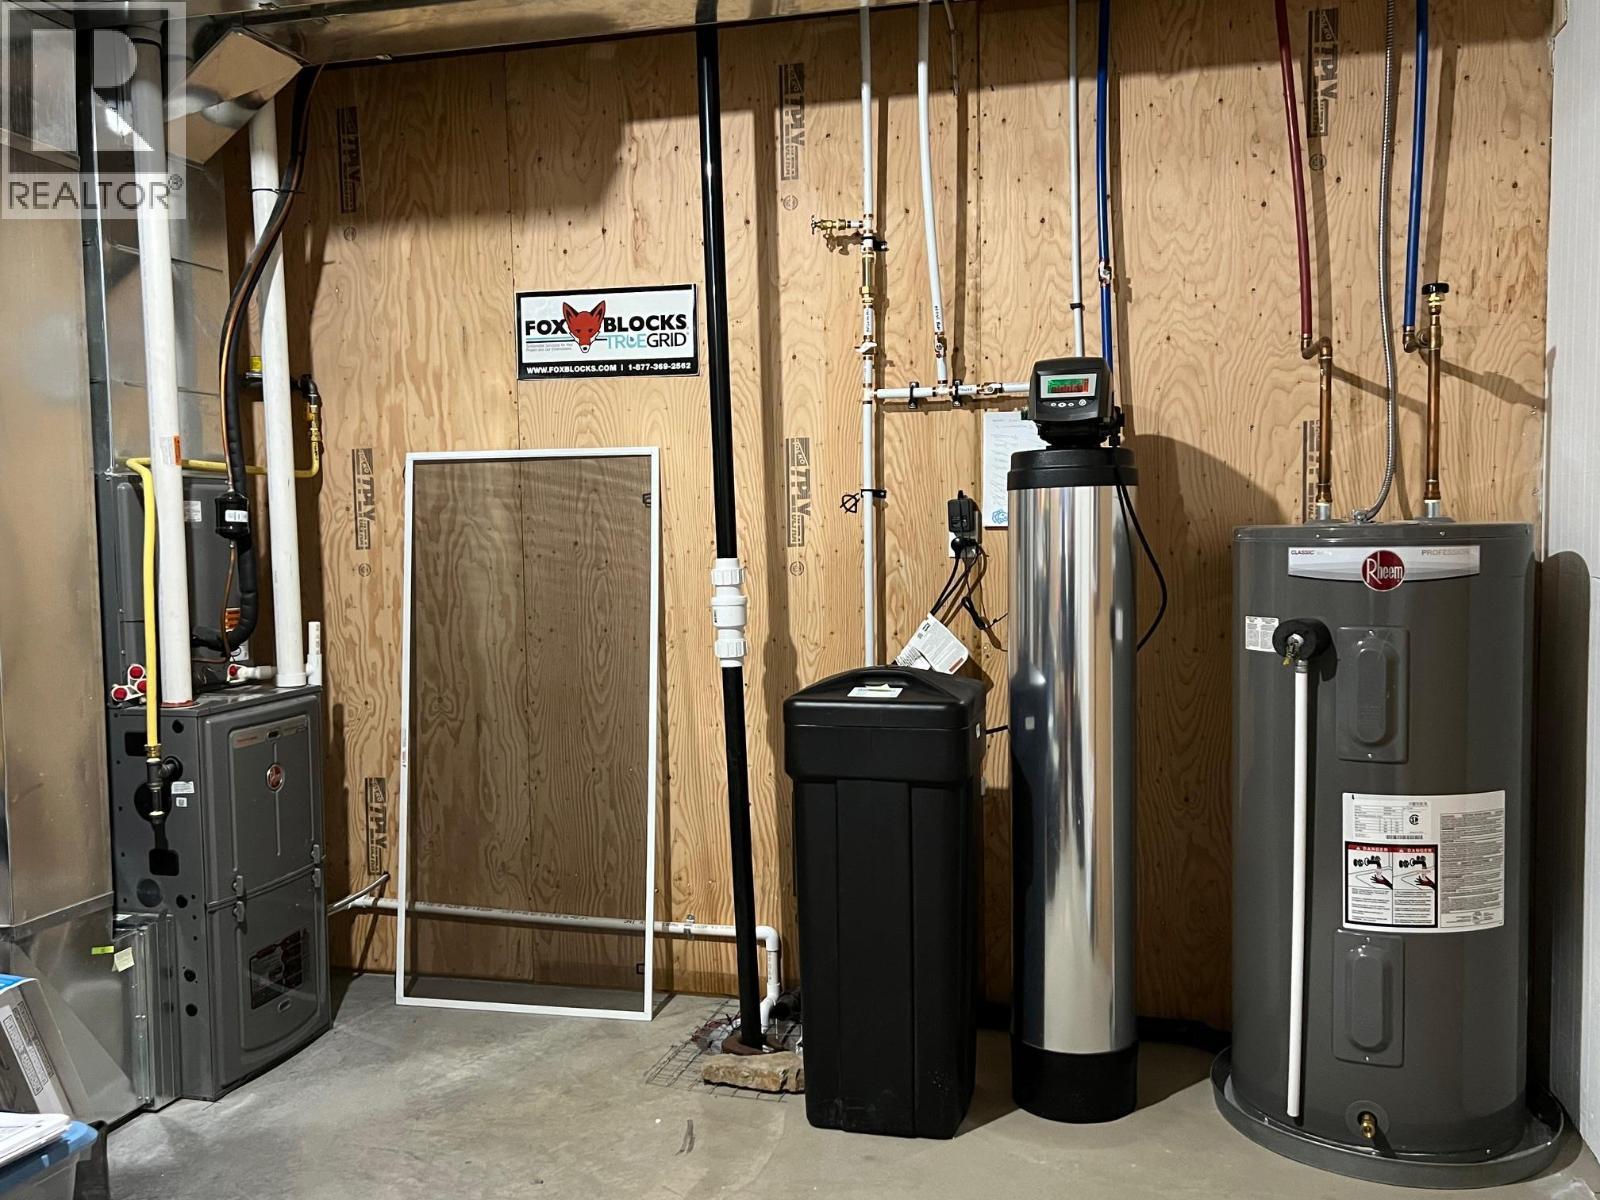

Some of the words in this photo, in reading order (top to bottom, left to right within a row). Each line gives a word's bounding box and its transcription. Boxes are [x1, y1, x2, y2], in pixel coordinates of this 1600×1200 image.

[525, 318, 568, 336] FOX
[603, 314, 687, 333] BLOCKS
[526, 364, 617, 374] WWW.FOXBLOCKS.COM
[628, 362, 692, 371] 1-877-369-2562
[1366, 551, 1403, 585] Rheem
